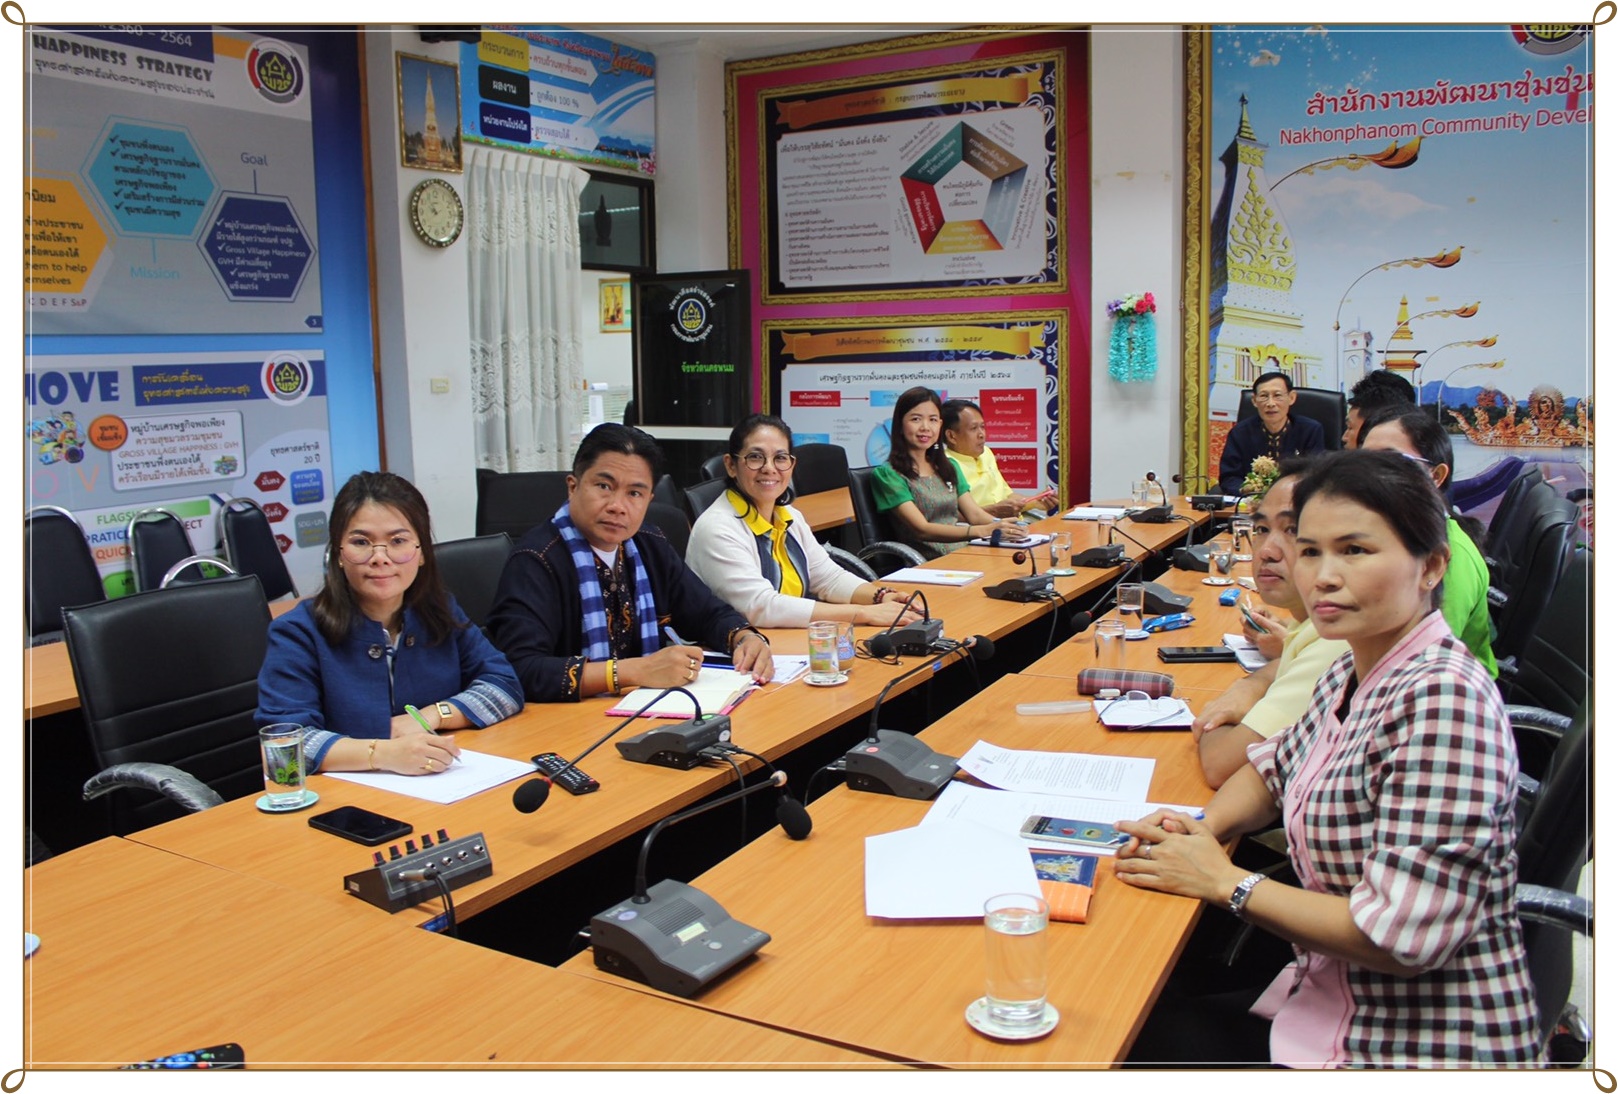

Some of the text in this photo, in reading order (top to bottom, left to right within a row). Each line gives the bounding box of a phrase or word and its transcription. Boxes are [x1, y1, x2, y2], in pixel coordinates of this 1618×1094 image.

[160, 31, 193, 47] 2564
[32, 33, 213, 82] HAPPINESS STRATEGY
[492, 79, 517, 95] ผลงาน
[1305, 65, 1593, 116] สำนักงานพัฒนาชุมชน
[536, 90, 557, 106] ถูกต้อง
[559, 97, 571, 108] 100
[1280, 105, 1593, 145] Nakhonphanom Community Devel
[240, 152, 268, 167] Goal
[225, 244, 306, 260] Gross Village Happiness
[52, 263, 63, 272] to
[65, 263, 88, 275] help
[130, 265, 180, 281] Mission
[130, 418, 226, 436] หมู่บ้านเศรษฐกิจพอเพียง
[119, 449, 146, 459] GROSS
[147, 447, 177, 457] VILLAGE
[180, 444, 218, 454] HAPPINESS
[304, 456, 314, 464] 20
